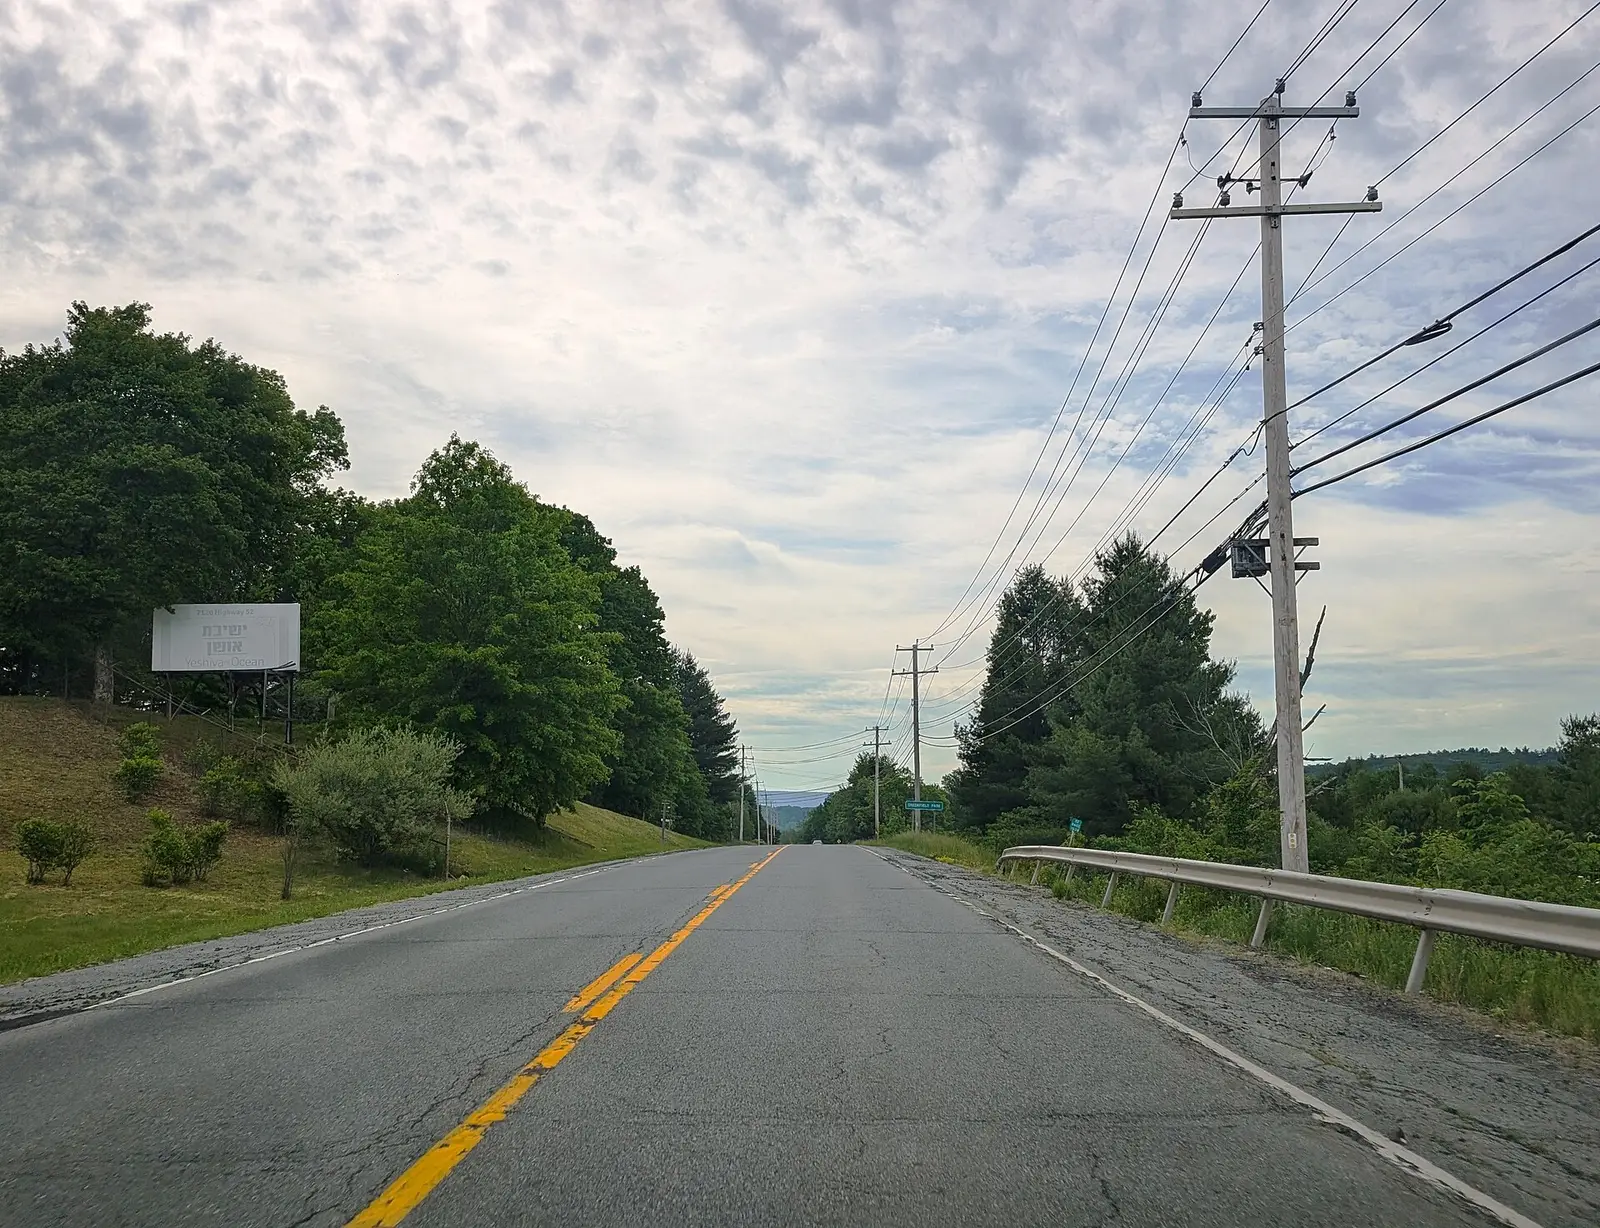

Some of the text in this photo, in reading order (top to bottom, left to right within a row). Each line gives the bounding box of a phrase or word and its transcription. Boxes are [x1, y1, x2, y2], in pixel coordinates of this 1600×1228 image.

[214, 609, 244, 617] Highway
[201, 624, 247, 637] ישיבת
[207, 641, 243, 656] אושן
[184, 657, 224, 668] Yeshiva
[231, 656, 265, 667] Ocean
